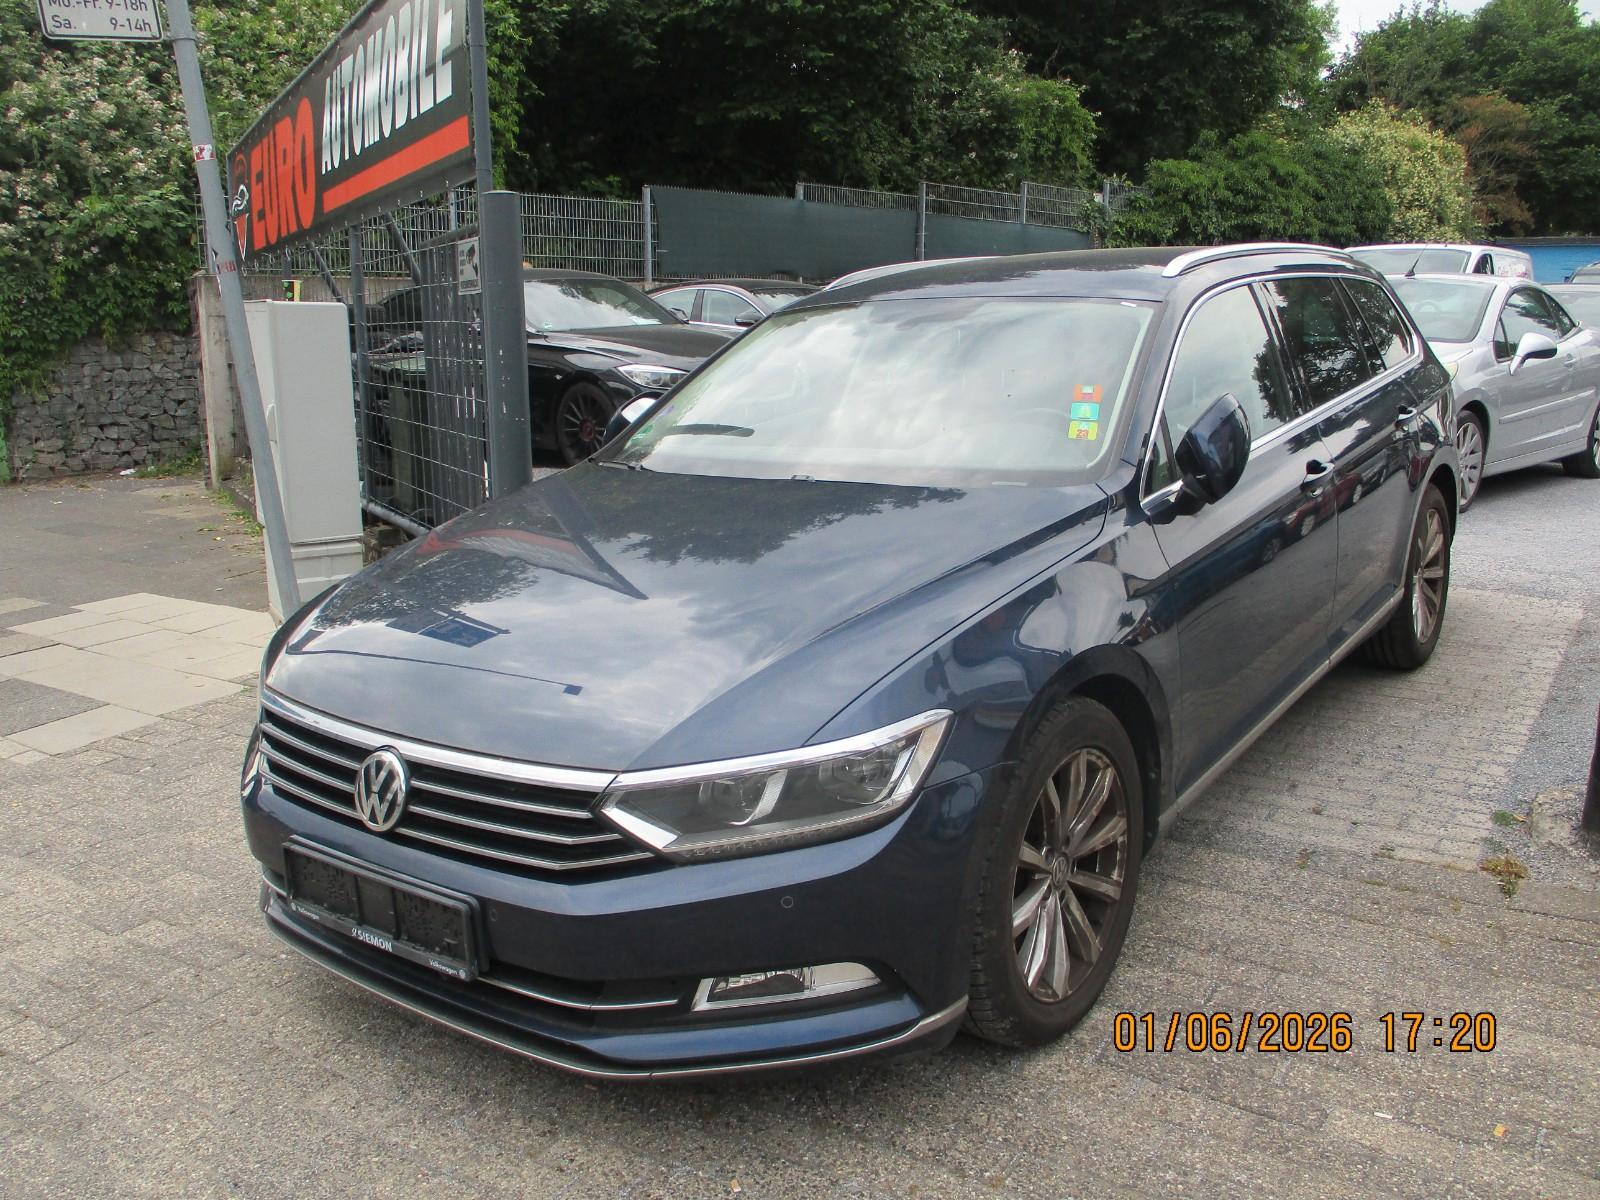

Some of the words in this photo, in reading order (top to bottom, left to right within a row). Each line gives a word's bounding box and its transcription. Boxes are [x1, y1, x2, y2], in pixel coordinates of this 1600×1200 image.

[51, 15, 77, 29] Sa.
[109, 17, 152, 32] 9-14h
[250, 97, 316, 250] EURO
[322, 0, 453, 175] AUTOMOBILE
